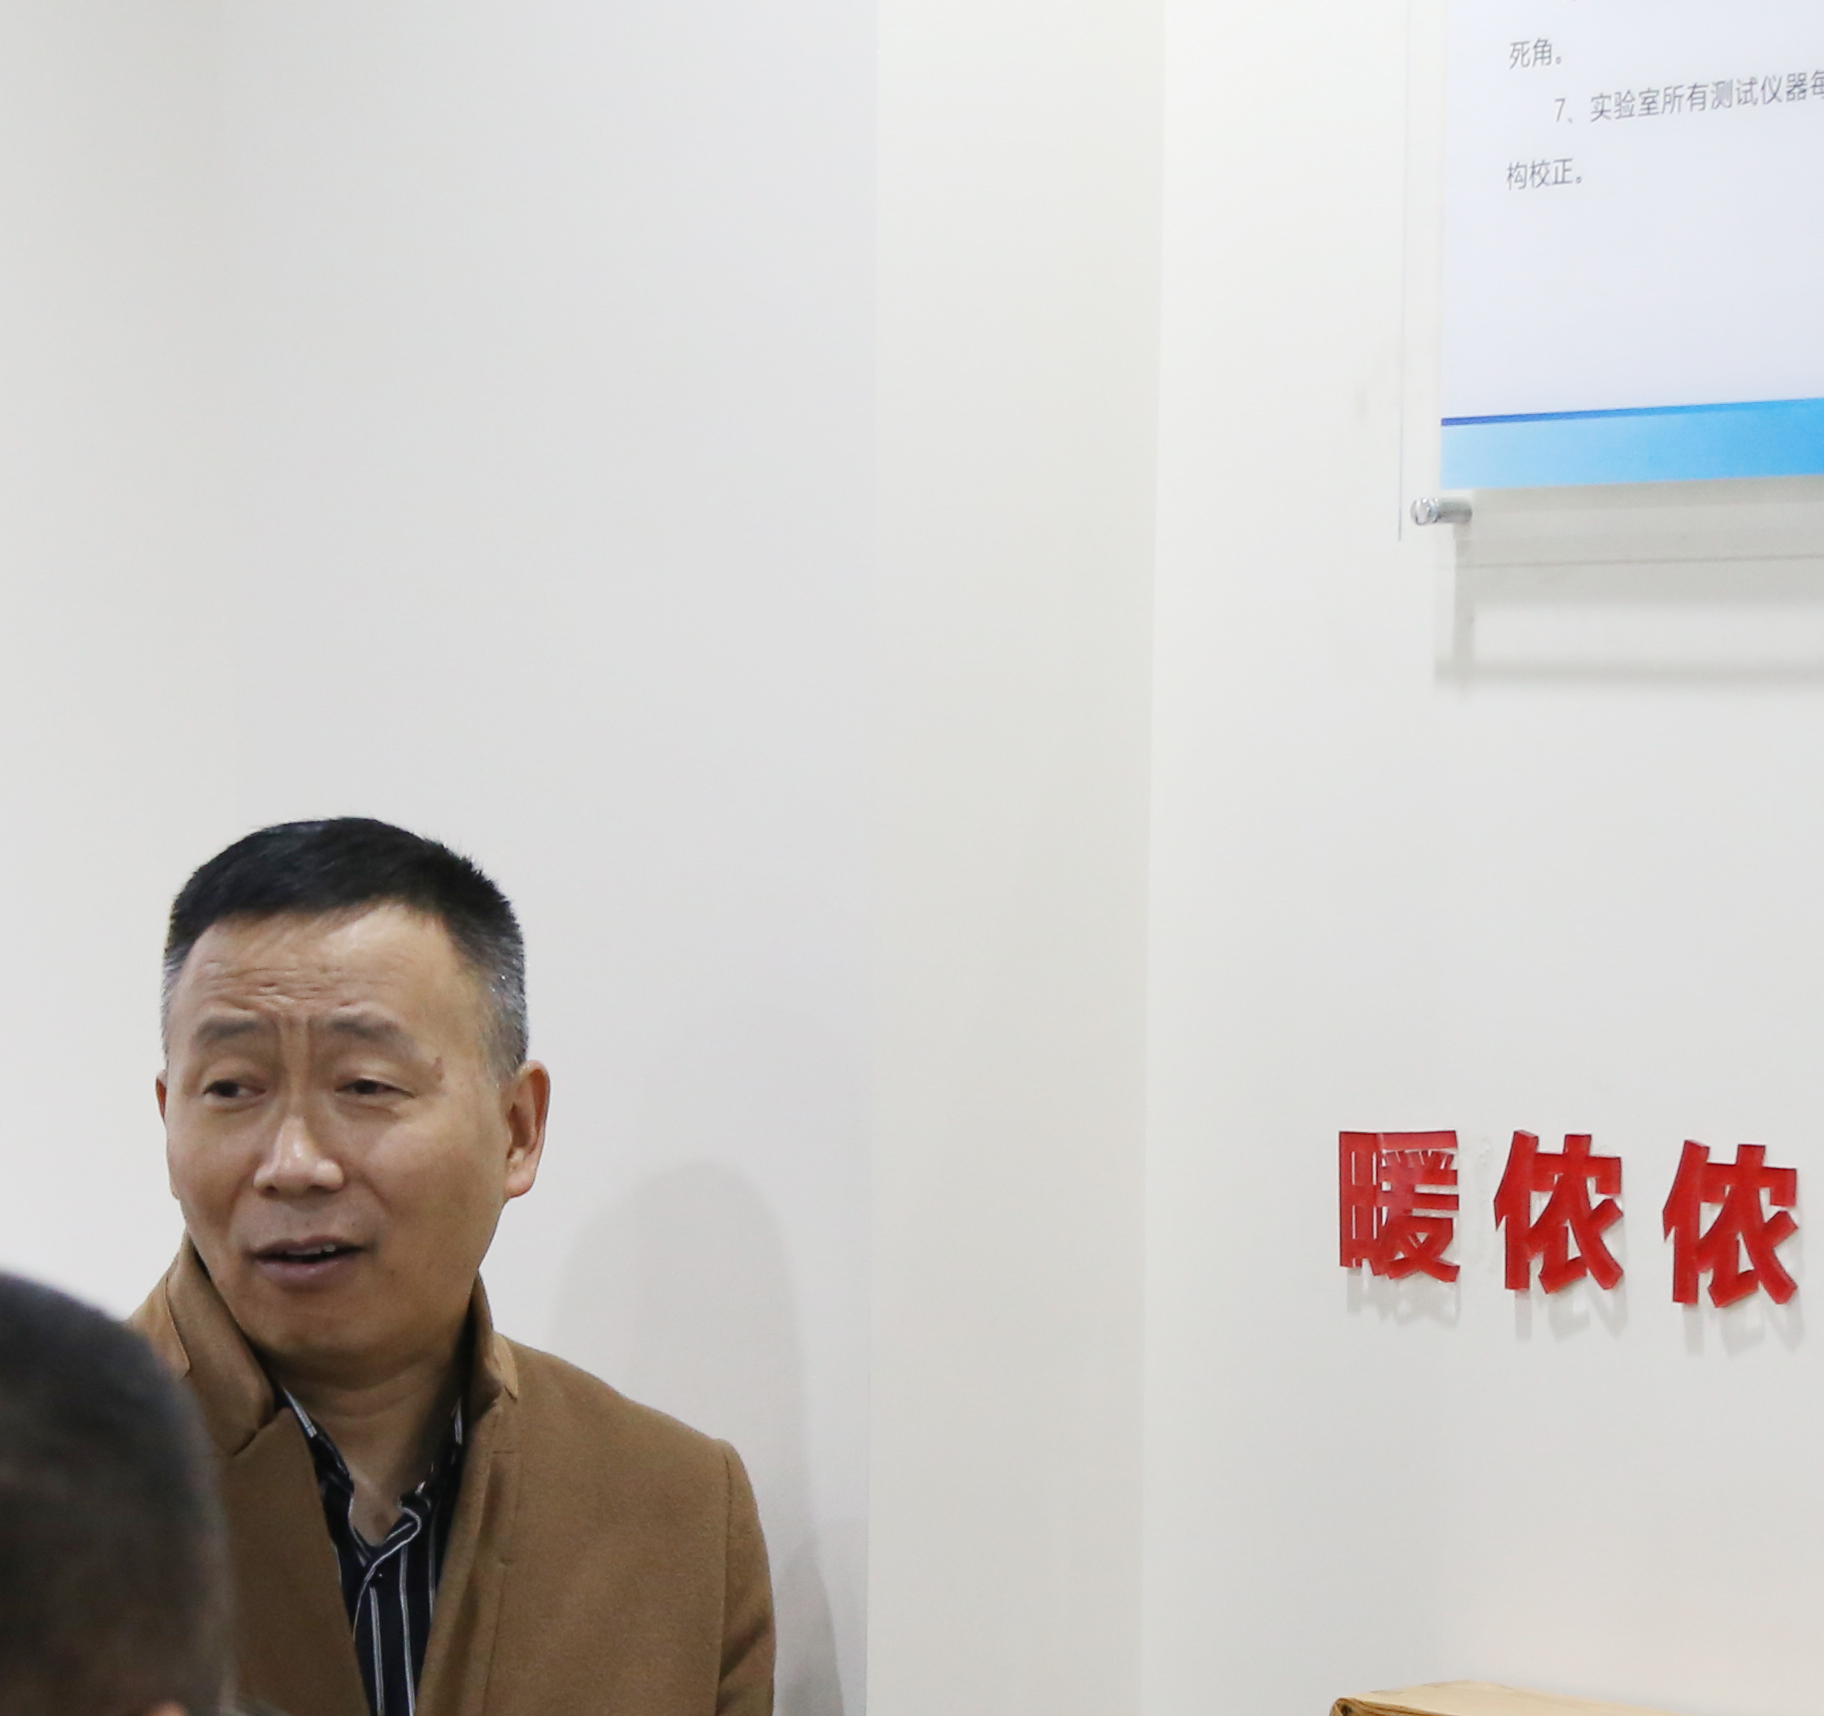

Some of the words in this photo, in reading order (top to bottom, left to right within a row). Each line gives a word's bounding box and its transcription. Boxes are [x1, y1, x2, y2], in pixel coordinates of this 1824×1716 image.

[1508, 37, 1562, 70] 死角。
[1506, 157, 1583, 191] 构校正。
